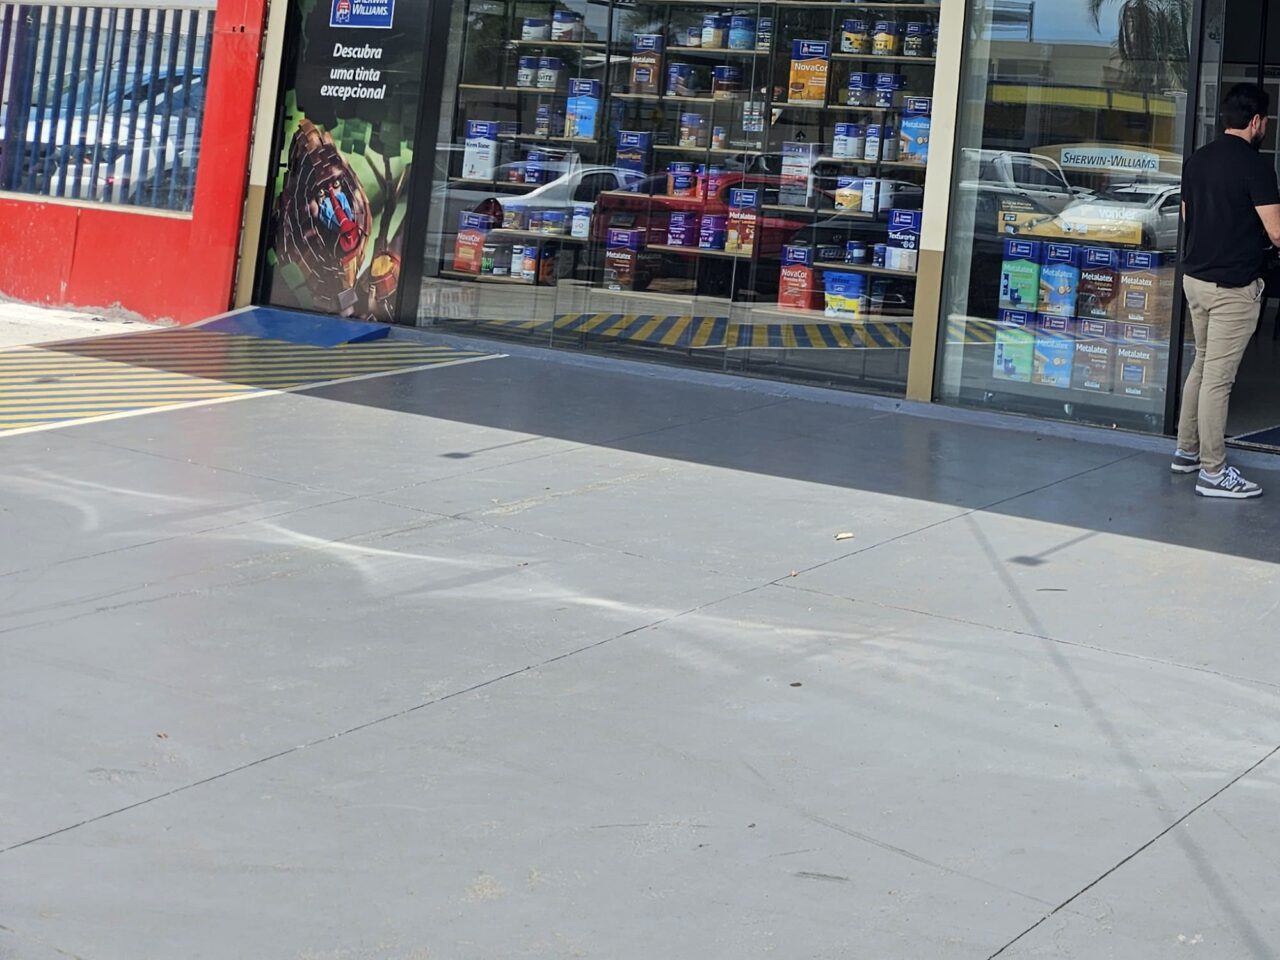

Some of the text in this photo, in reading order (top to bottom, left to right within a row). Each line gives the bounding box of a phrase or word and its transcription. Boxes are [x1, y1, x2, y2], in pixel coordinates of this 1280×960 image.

[333, 43, 383, 59] Descubra
[330, 66, 381, 81] uma tinta
[320, 83, 387, 101] excepcional
[1081, 272, 1113, 283] Metalatex
[1121, 275, 1152, 286] Metalatex
[1076, 343, 1108, 354] Metalatex
[1118, 347, 1150, 360] Metalatex
